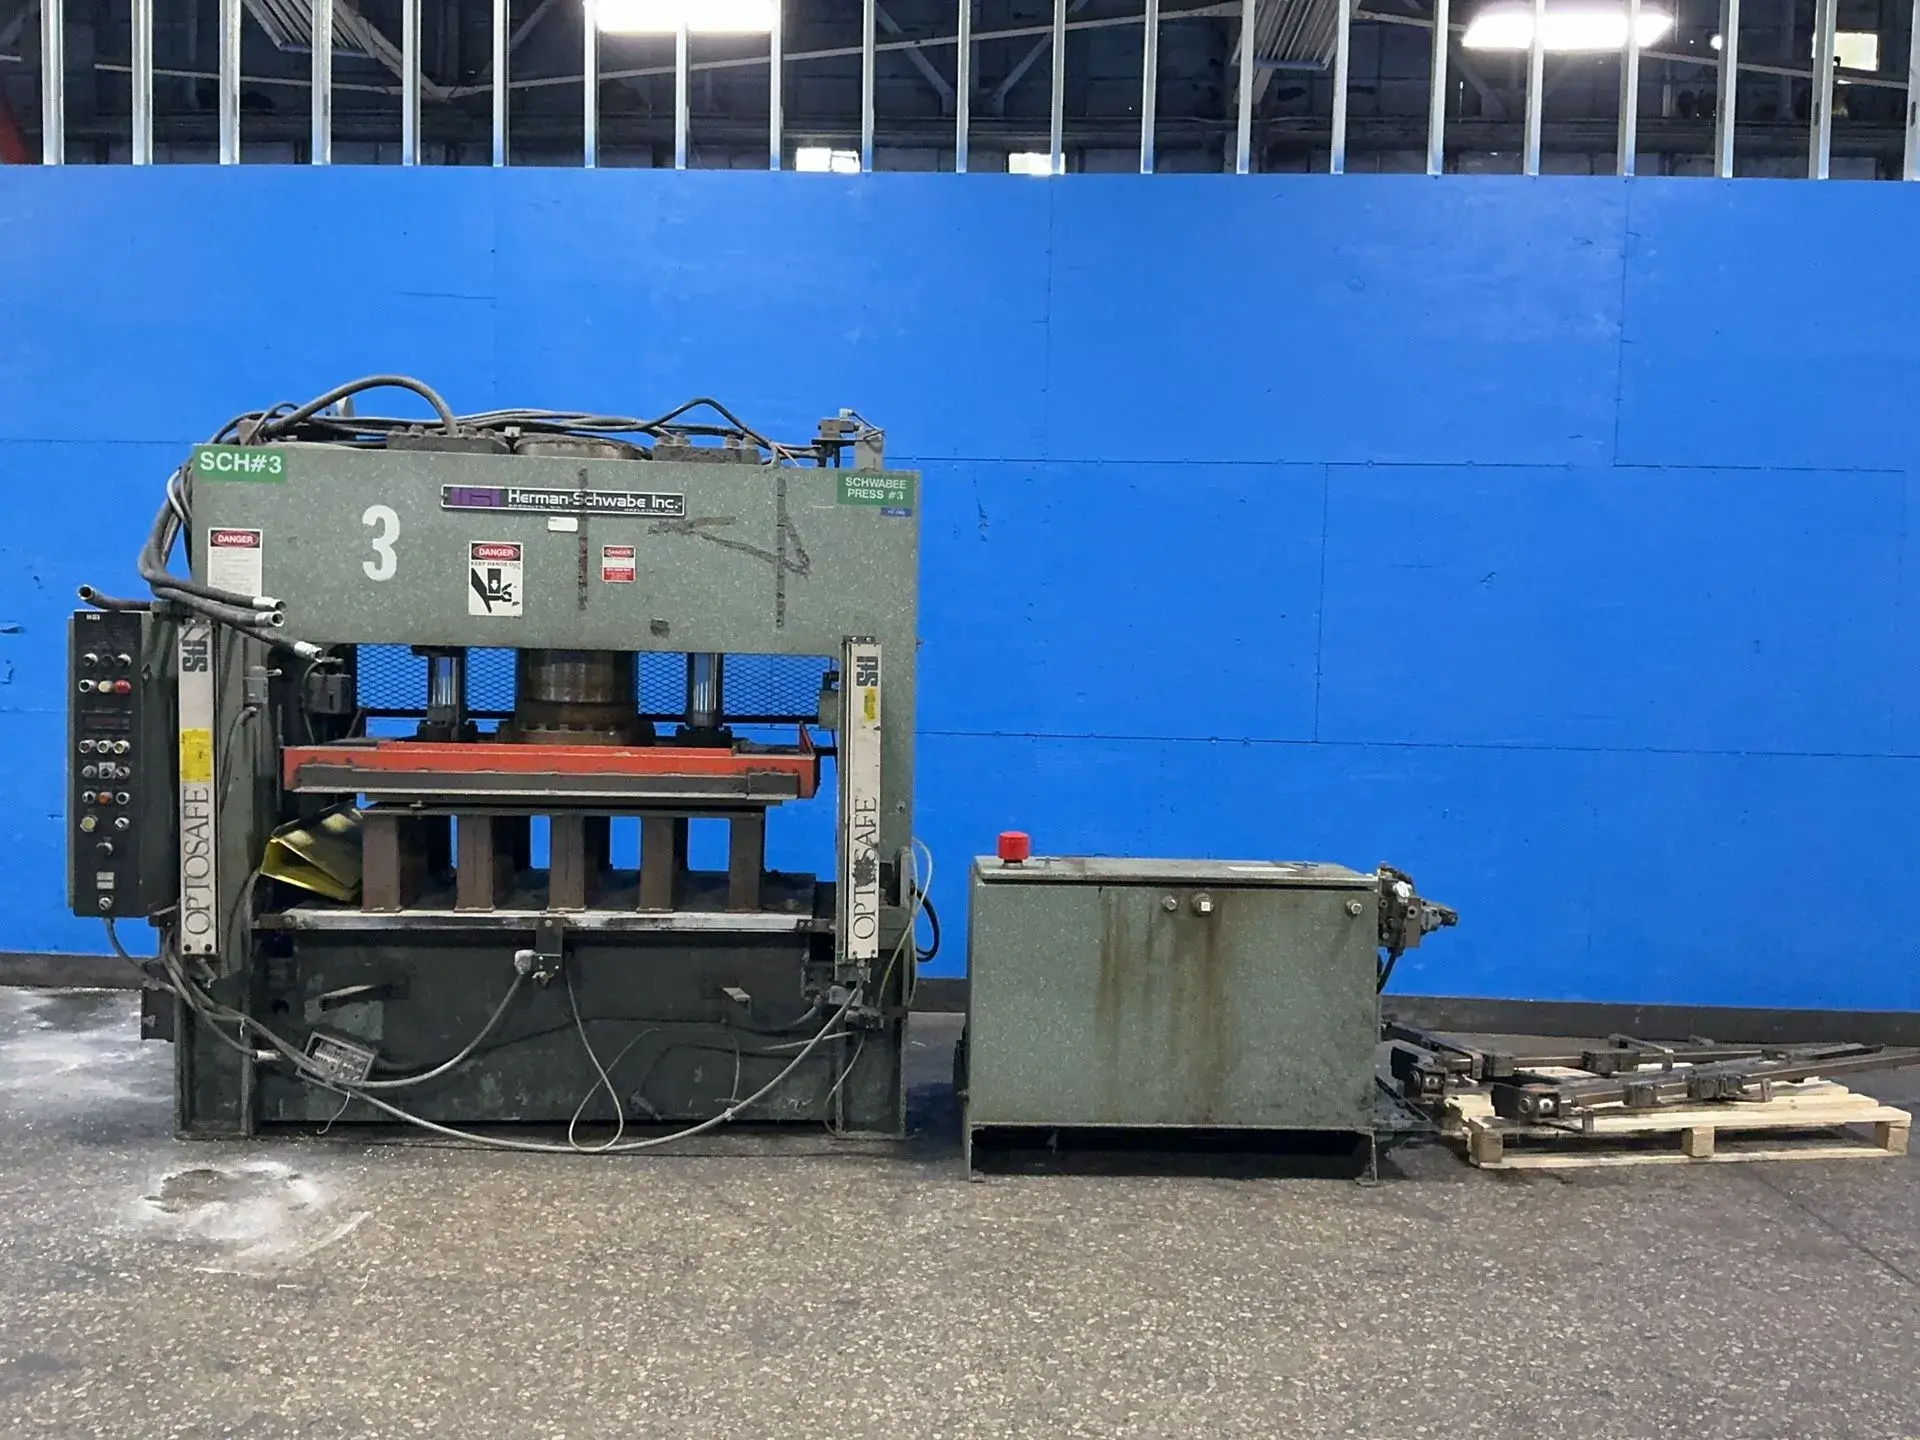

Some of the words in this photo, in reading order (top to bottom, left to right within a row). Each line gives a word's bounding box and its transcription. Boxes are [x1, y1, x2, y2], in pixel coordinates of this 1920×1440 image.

[200, 451, 282, 474] SCH#3
[845, 477, 907, 489] SCHWABEE
[847, 488, 884, 500] PRESS
[888, 490, 904, 500] #3
[652, 495, 679, 509] Inc.
[218, 534, 254, 544] DANGER
[362, 504, 400, 581] 3
[478, 548, 514, 557] DANGER
[183, 786, 209, 935] OPTOSAFE
[853, 796, 877, 940] OPTSAFE
